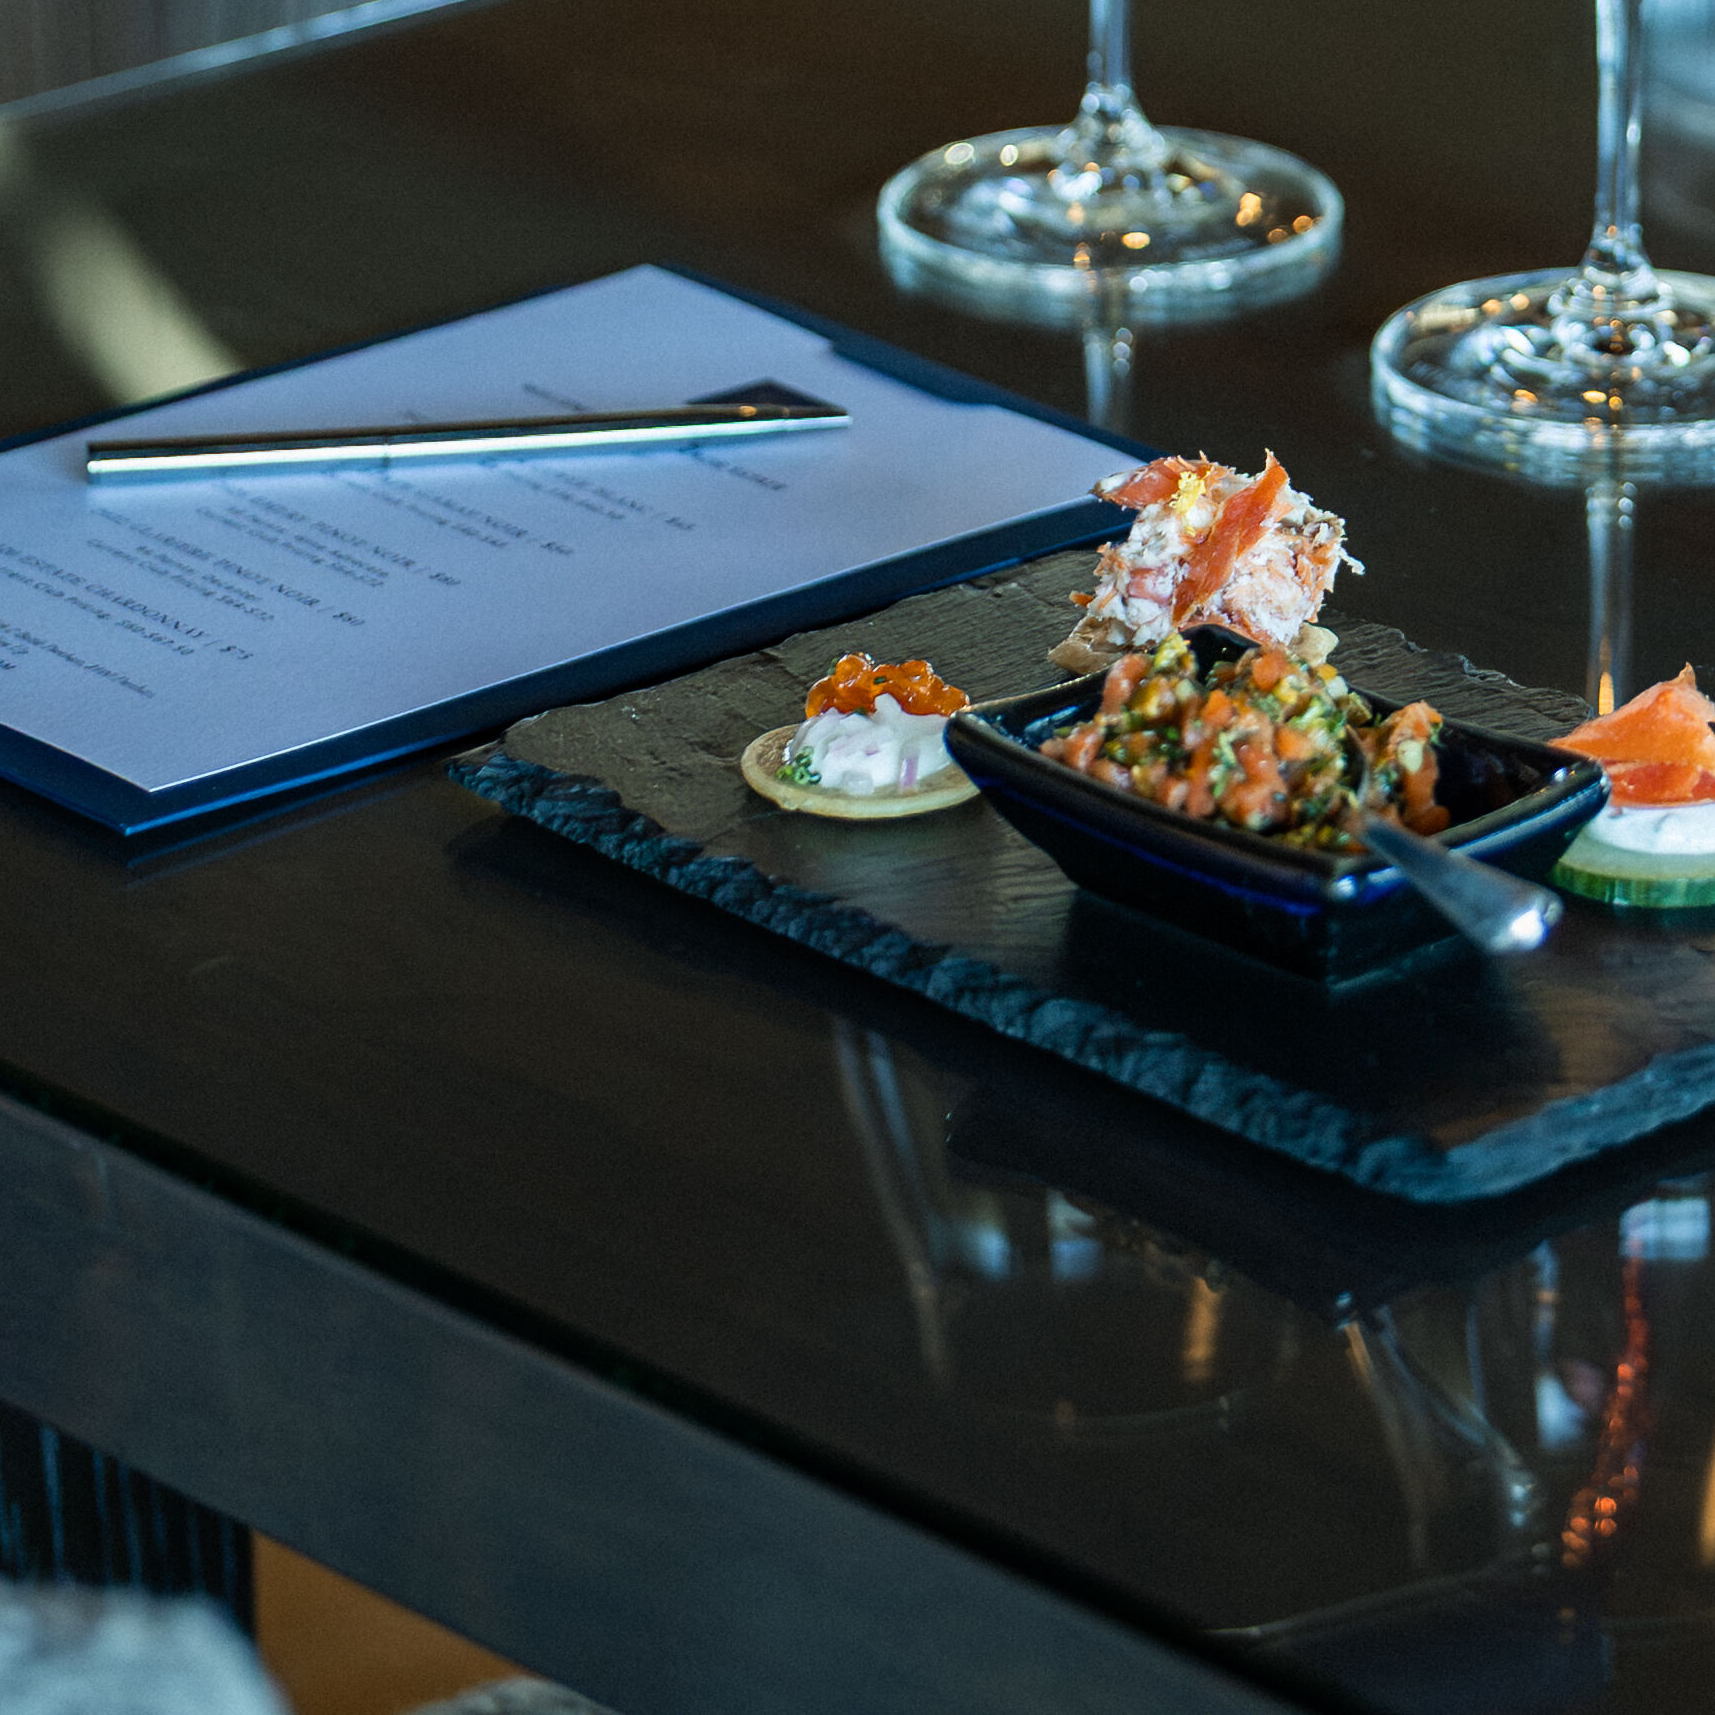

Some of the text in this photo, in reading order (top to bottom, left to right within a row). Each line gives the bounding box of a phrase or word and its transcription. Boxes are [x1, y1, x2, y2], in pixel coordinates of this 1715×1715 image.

[310, 521, 368, 546] PINOT
[368, 546, 416, 566] NOIR
[16, 556, 85, 585] ESTATE
[81, 584, 209, 639] CHARDONNAY
[212, 559, 273, 585] PINOT
[270, 584, 321, 606] NOIR
